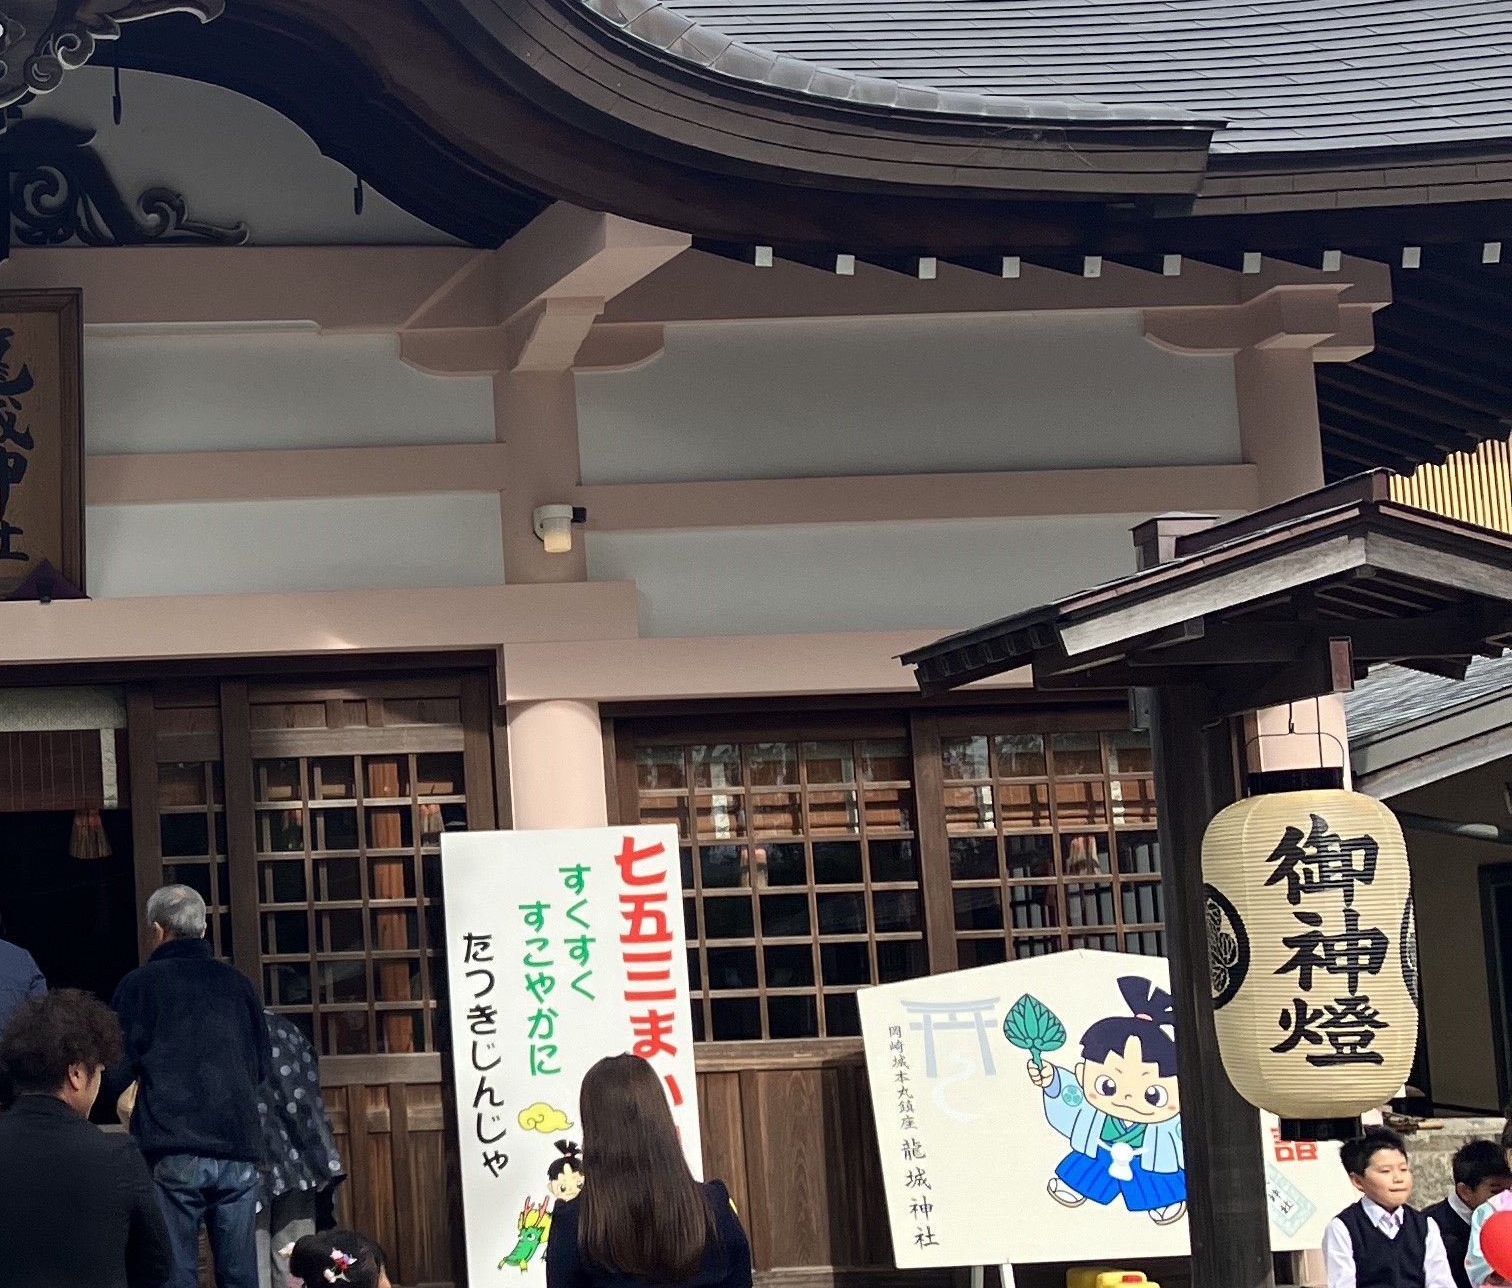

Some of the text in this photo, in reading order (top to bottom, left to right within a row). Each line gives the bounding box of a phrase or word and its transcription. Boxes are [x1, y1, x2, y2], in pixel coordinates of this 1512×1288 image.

[518, 901, 561, 1076] すこやかに
[559, 864, 596, 1001] すくすく
[1264, 813, 1390, 1067] 御神燈
[463, 932, 509, 1178] たつきじんじゃ
[900, 1137, 940, 1250] 龍城神社
